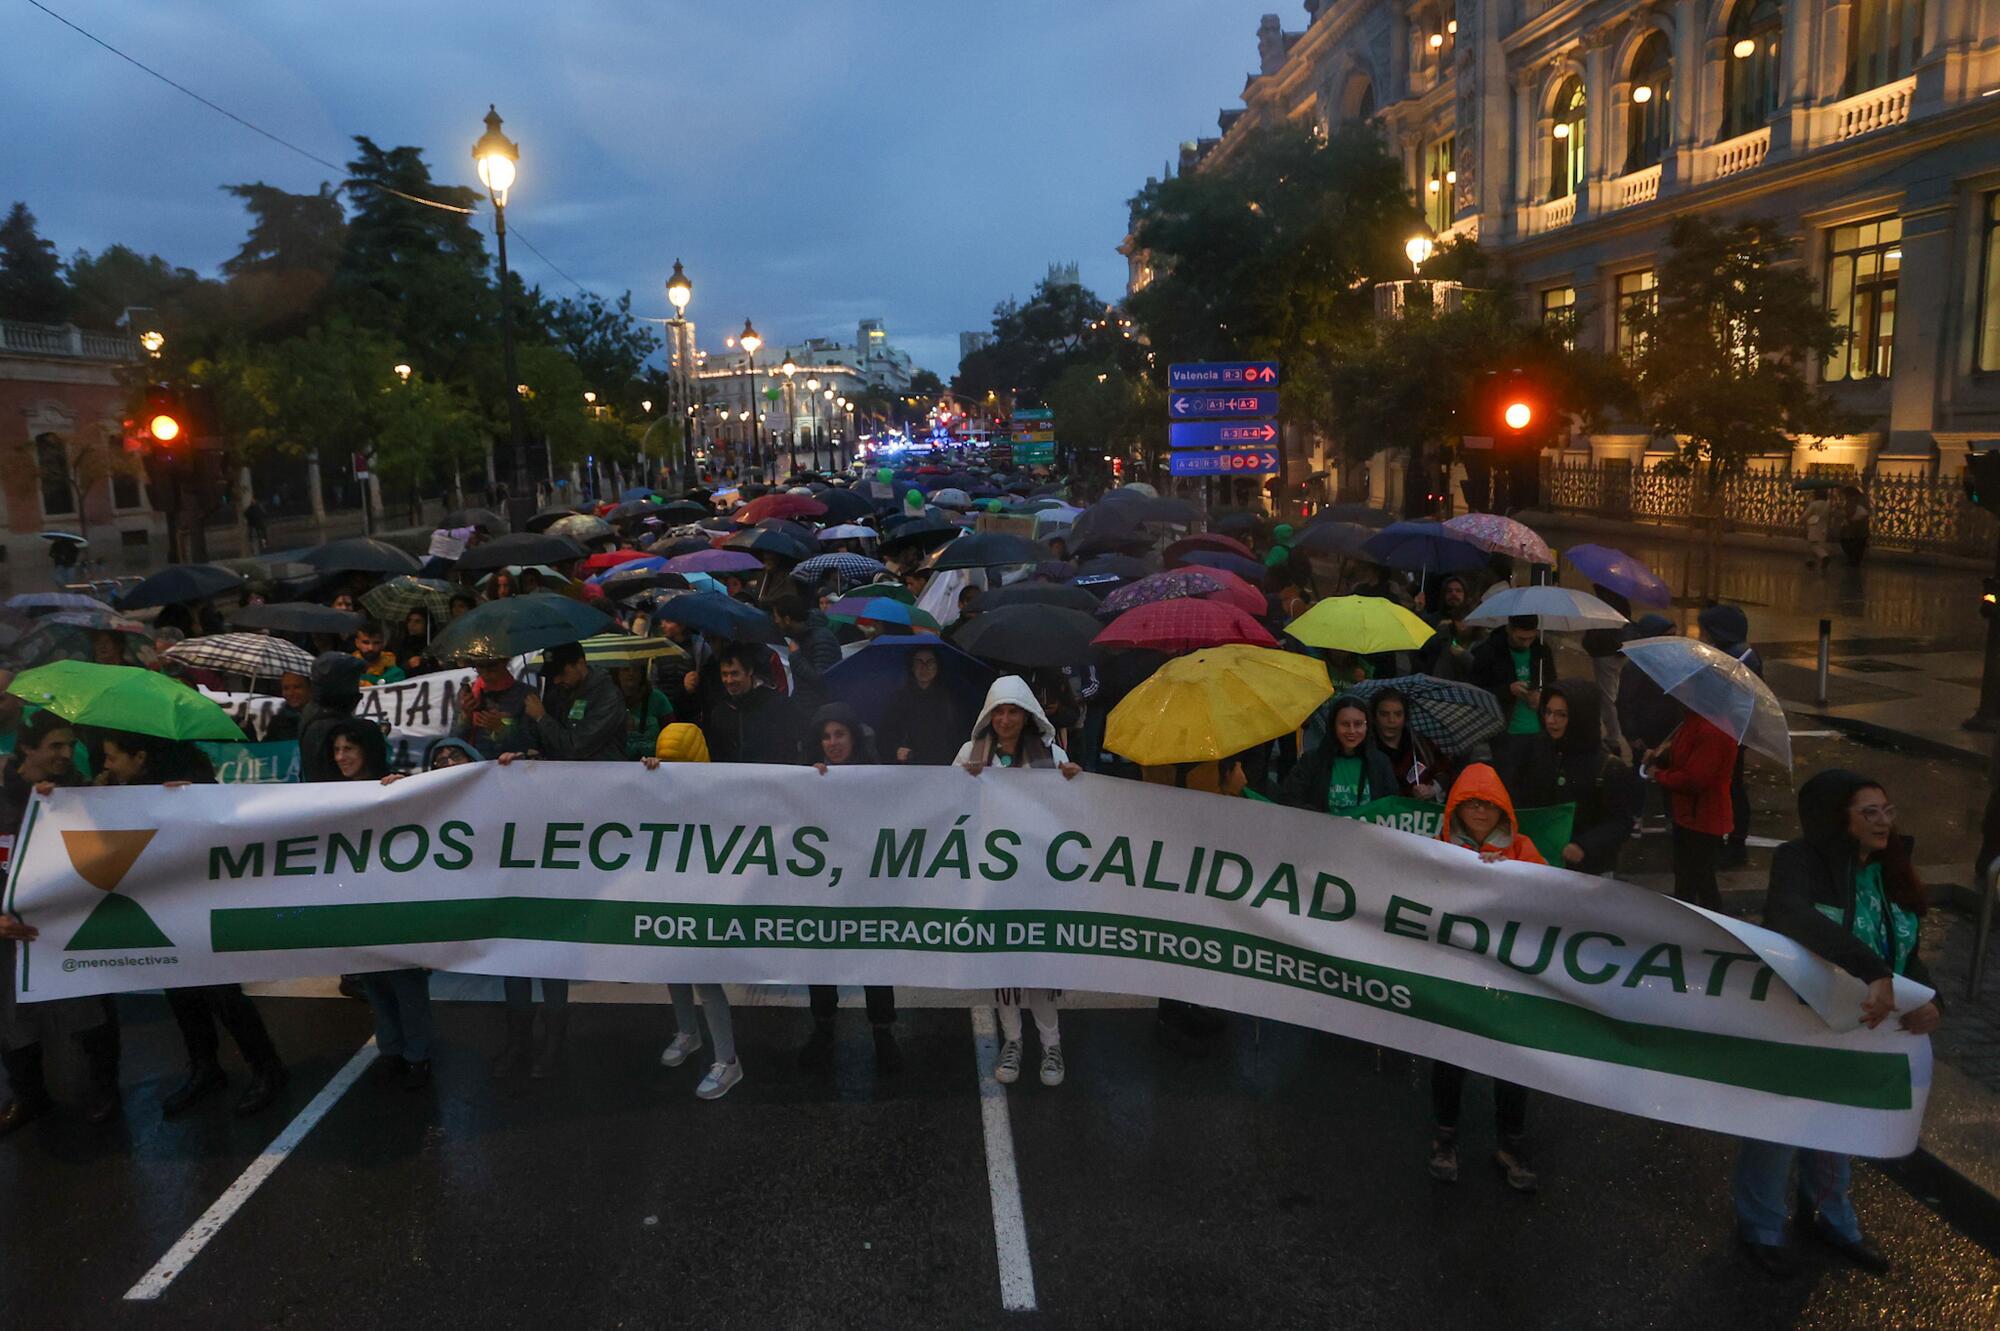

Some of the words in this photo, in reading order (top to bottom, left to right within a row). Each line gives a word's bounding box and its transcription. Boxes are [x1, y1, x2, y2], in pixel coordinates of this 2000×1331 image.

[1173, 370, 1219, 380] Valencia
[214, 746, 301, 784] CUELA
[209, 820, 474, 880] MENOS
[499, 822, 844, 887] LECTIVAS,
[869, 814, 1022, 882] MÁS
[1046, 830, 1357, 922] CALIDAD
[1384, 895, 1808, 1005] EDUCATI
[62, 954, 179, 973] @menoslectivas
[634, 915, 697, 941] POR
[706, 917, 746, 942] LA
[754, 917, 995, 946] RECUPERACIÓN
[1005, 922, 1047, 946] DE
[1056, 923, 1223, 964] NUESTROS
[1232, 944, 1412, 1009] DERECHOS
